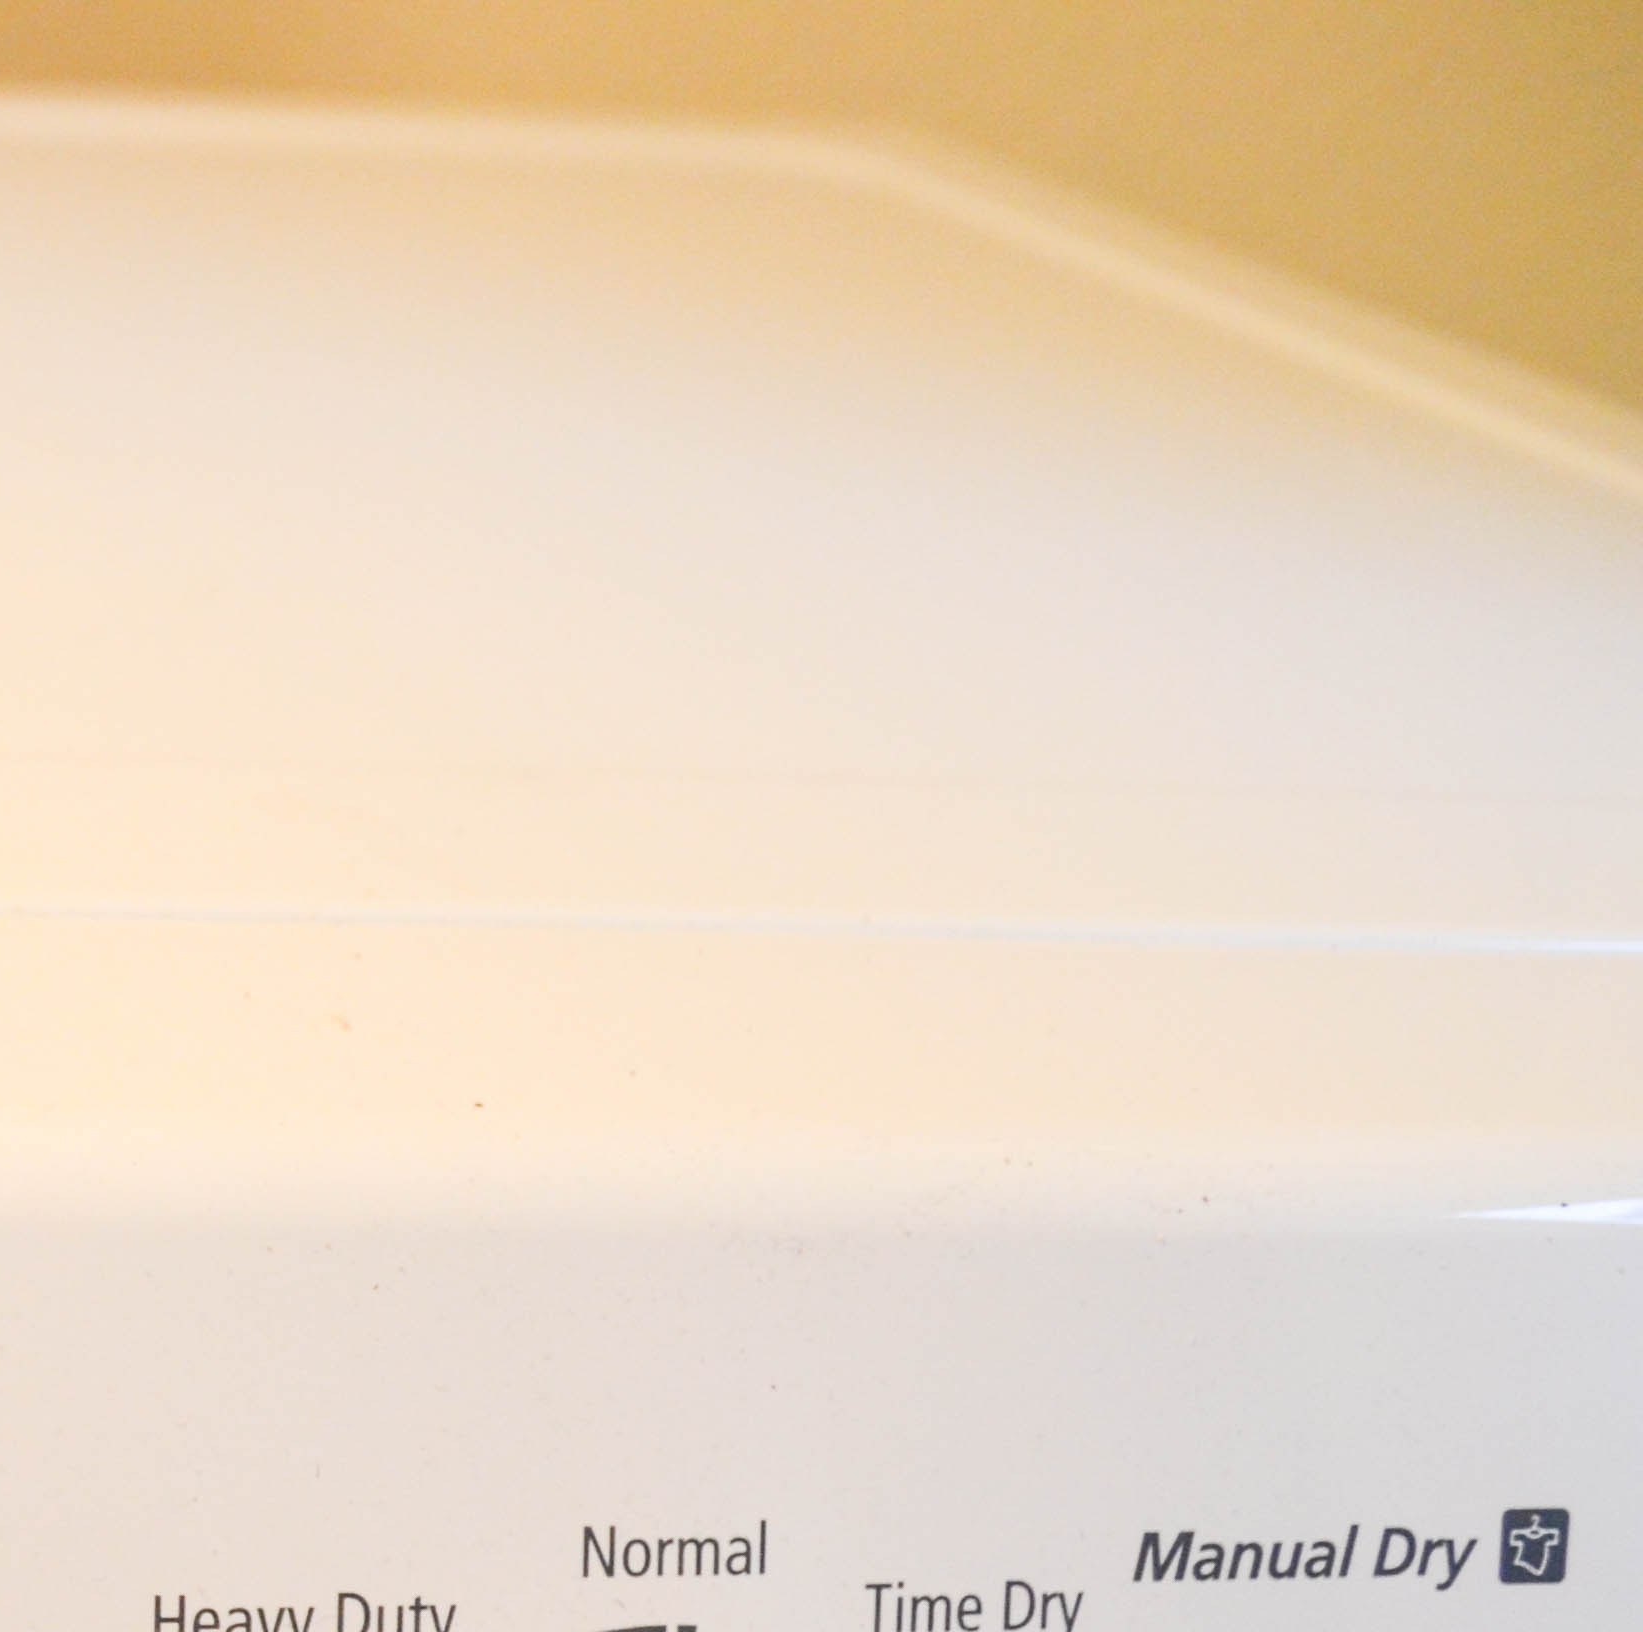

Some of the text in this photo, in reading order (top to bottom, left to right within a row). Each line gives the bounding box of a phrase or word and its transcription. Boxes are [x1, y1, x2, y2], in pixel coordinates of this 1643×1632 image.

[583, 1518, 767, 1578] Normal
[1133, 1524, 1478, 1592] Manual Dry
